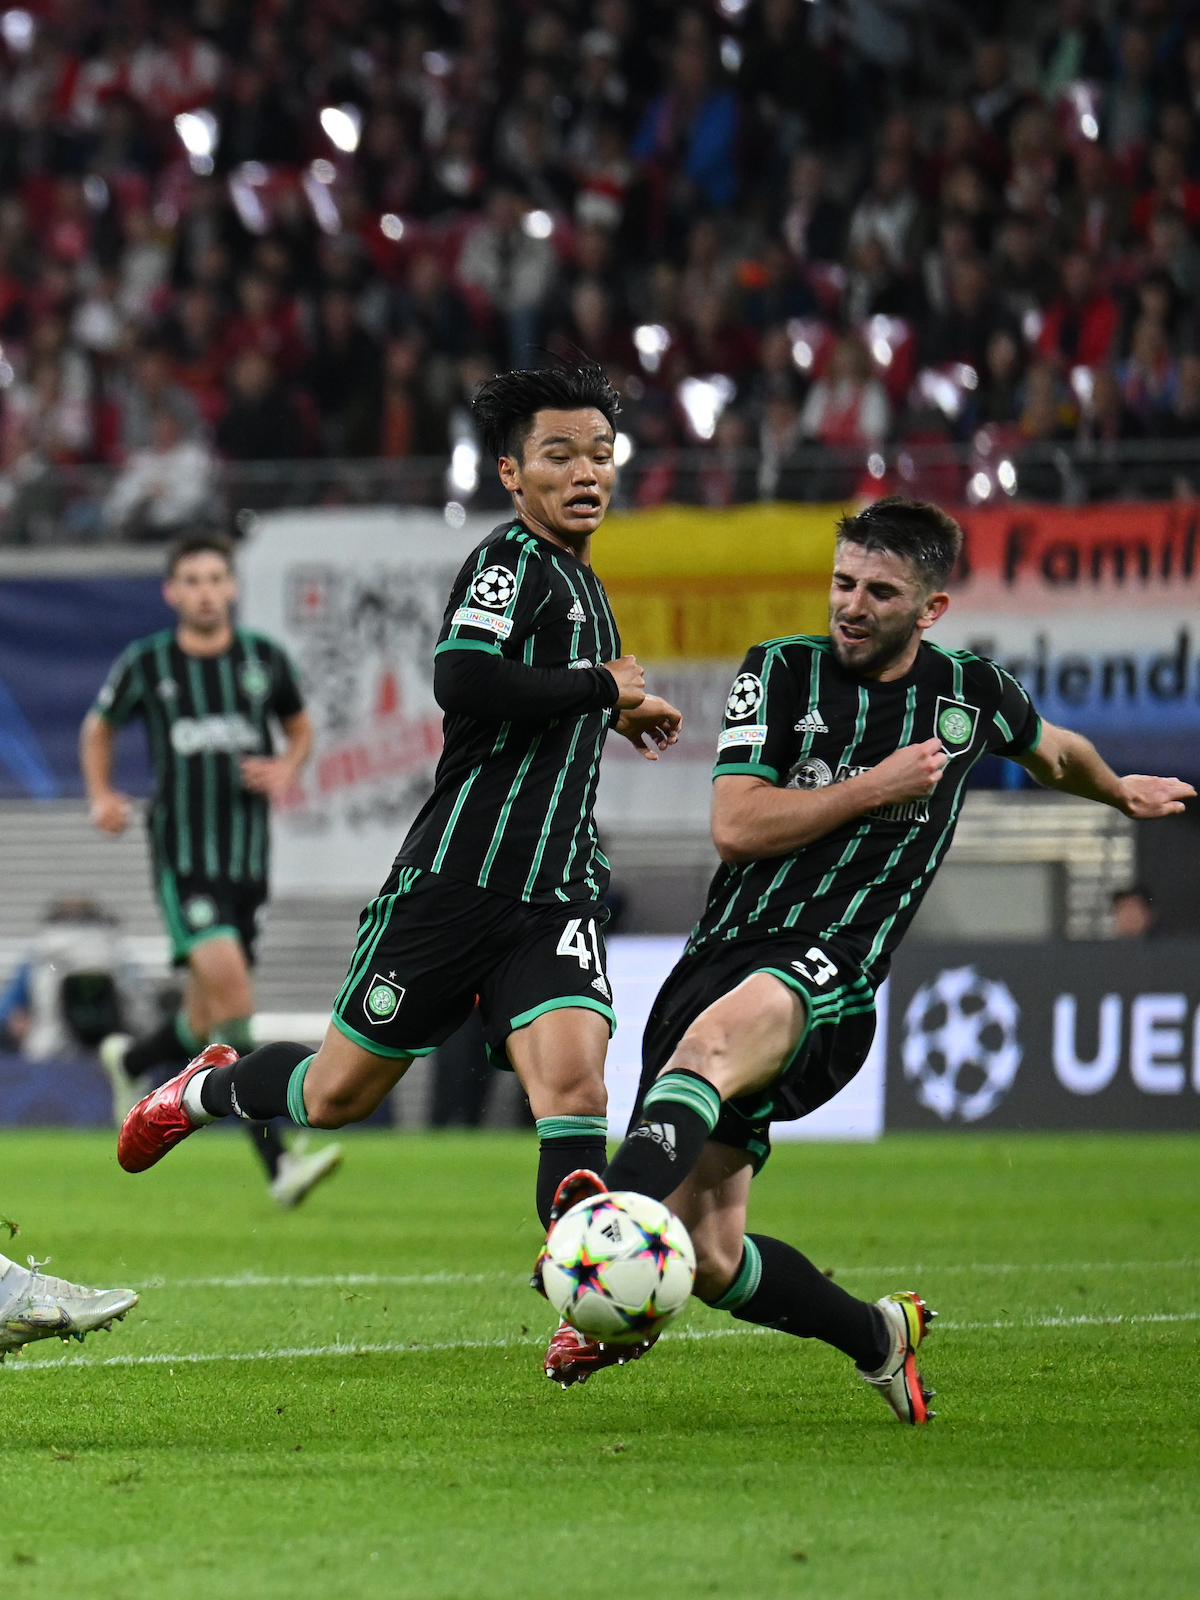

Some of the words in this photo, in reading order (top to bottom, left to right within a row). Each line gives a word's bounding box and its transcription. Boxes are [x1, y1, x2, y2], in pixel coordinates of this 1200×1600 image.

[454, 612, 511, 631] FOUNDATION
[794, 722, 829, 733] adidas
[556, 917, 604, 976] 41
[790, 946, 839, 986] 3
[1052, 992, 1200, 1096] UE
